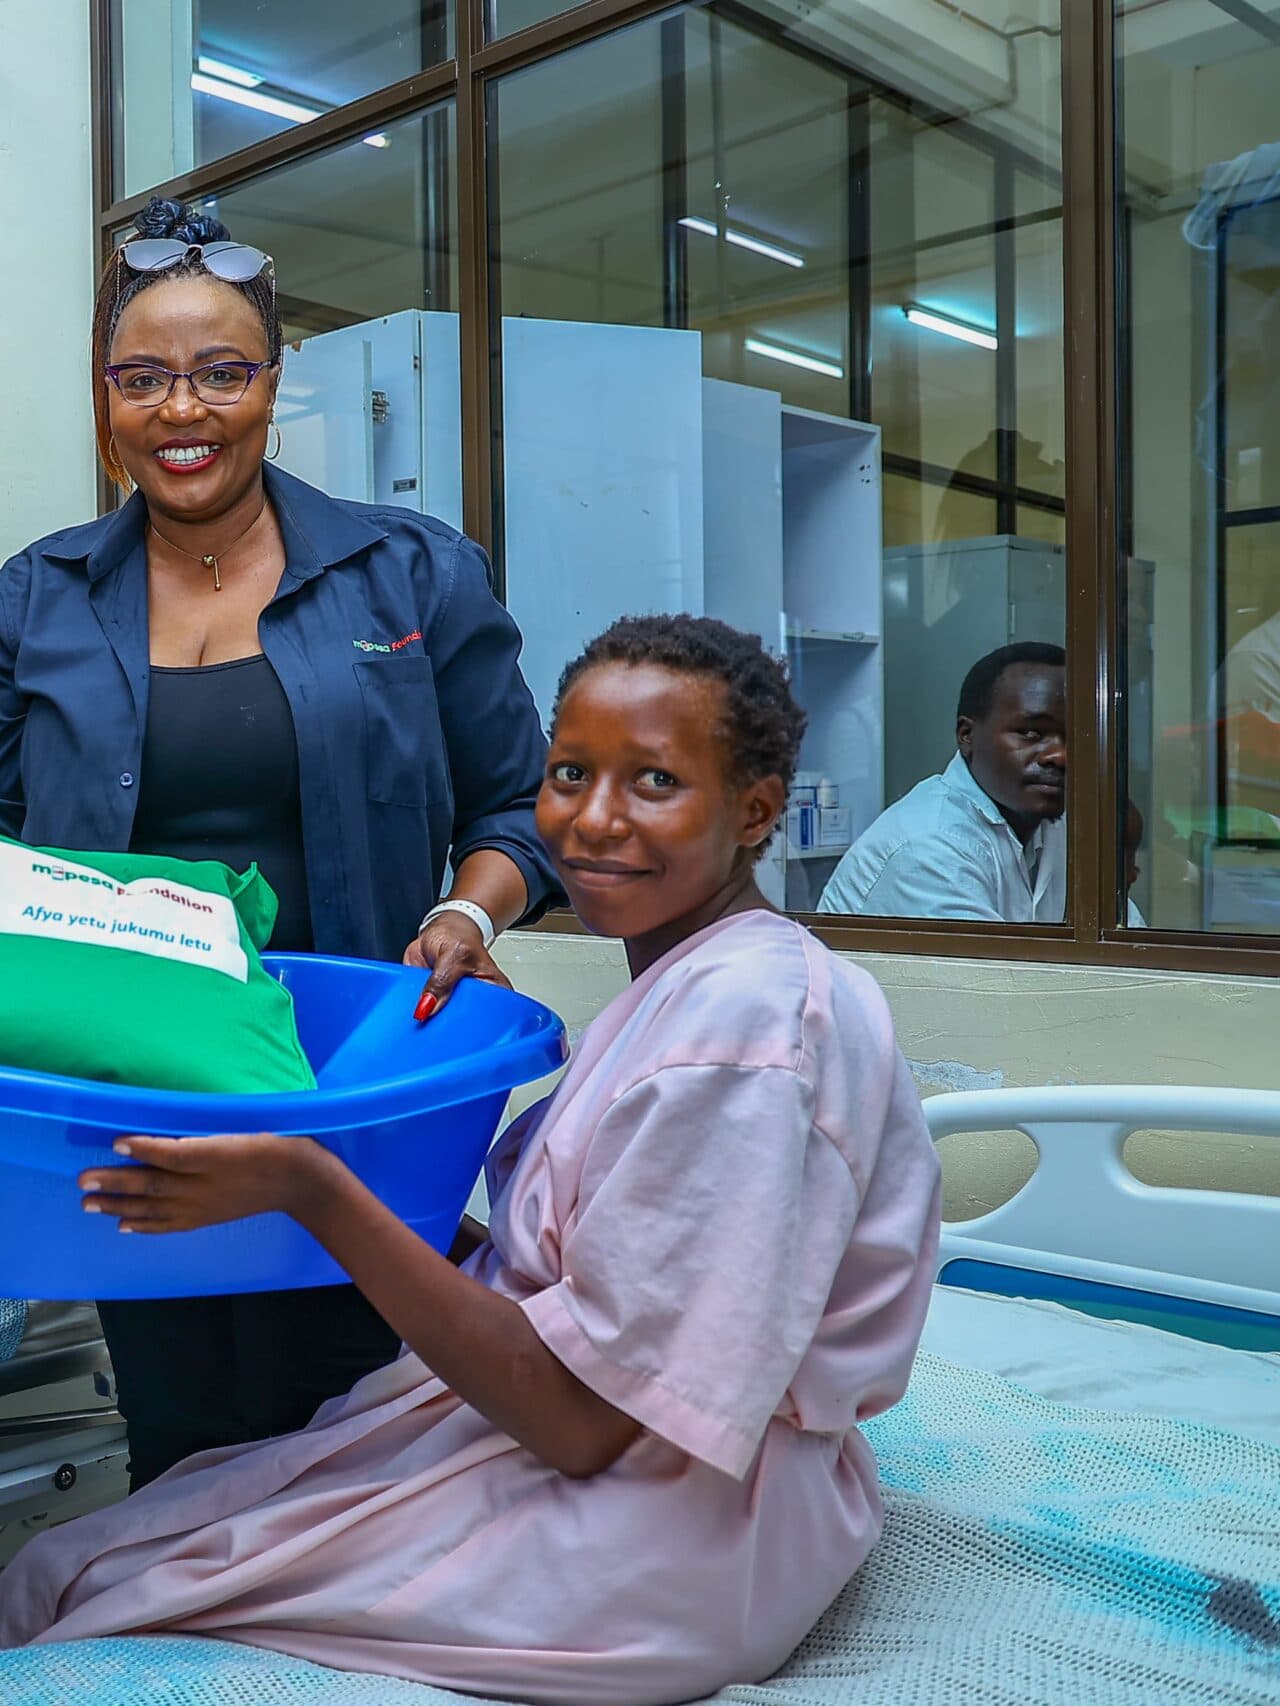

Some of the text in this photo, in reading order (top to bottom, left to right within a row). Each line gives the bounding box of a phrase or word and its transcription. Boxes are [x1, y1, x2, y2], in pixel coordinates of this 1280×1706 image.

[22, 905, 212, 952] Afya yetu jukumu letu
